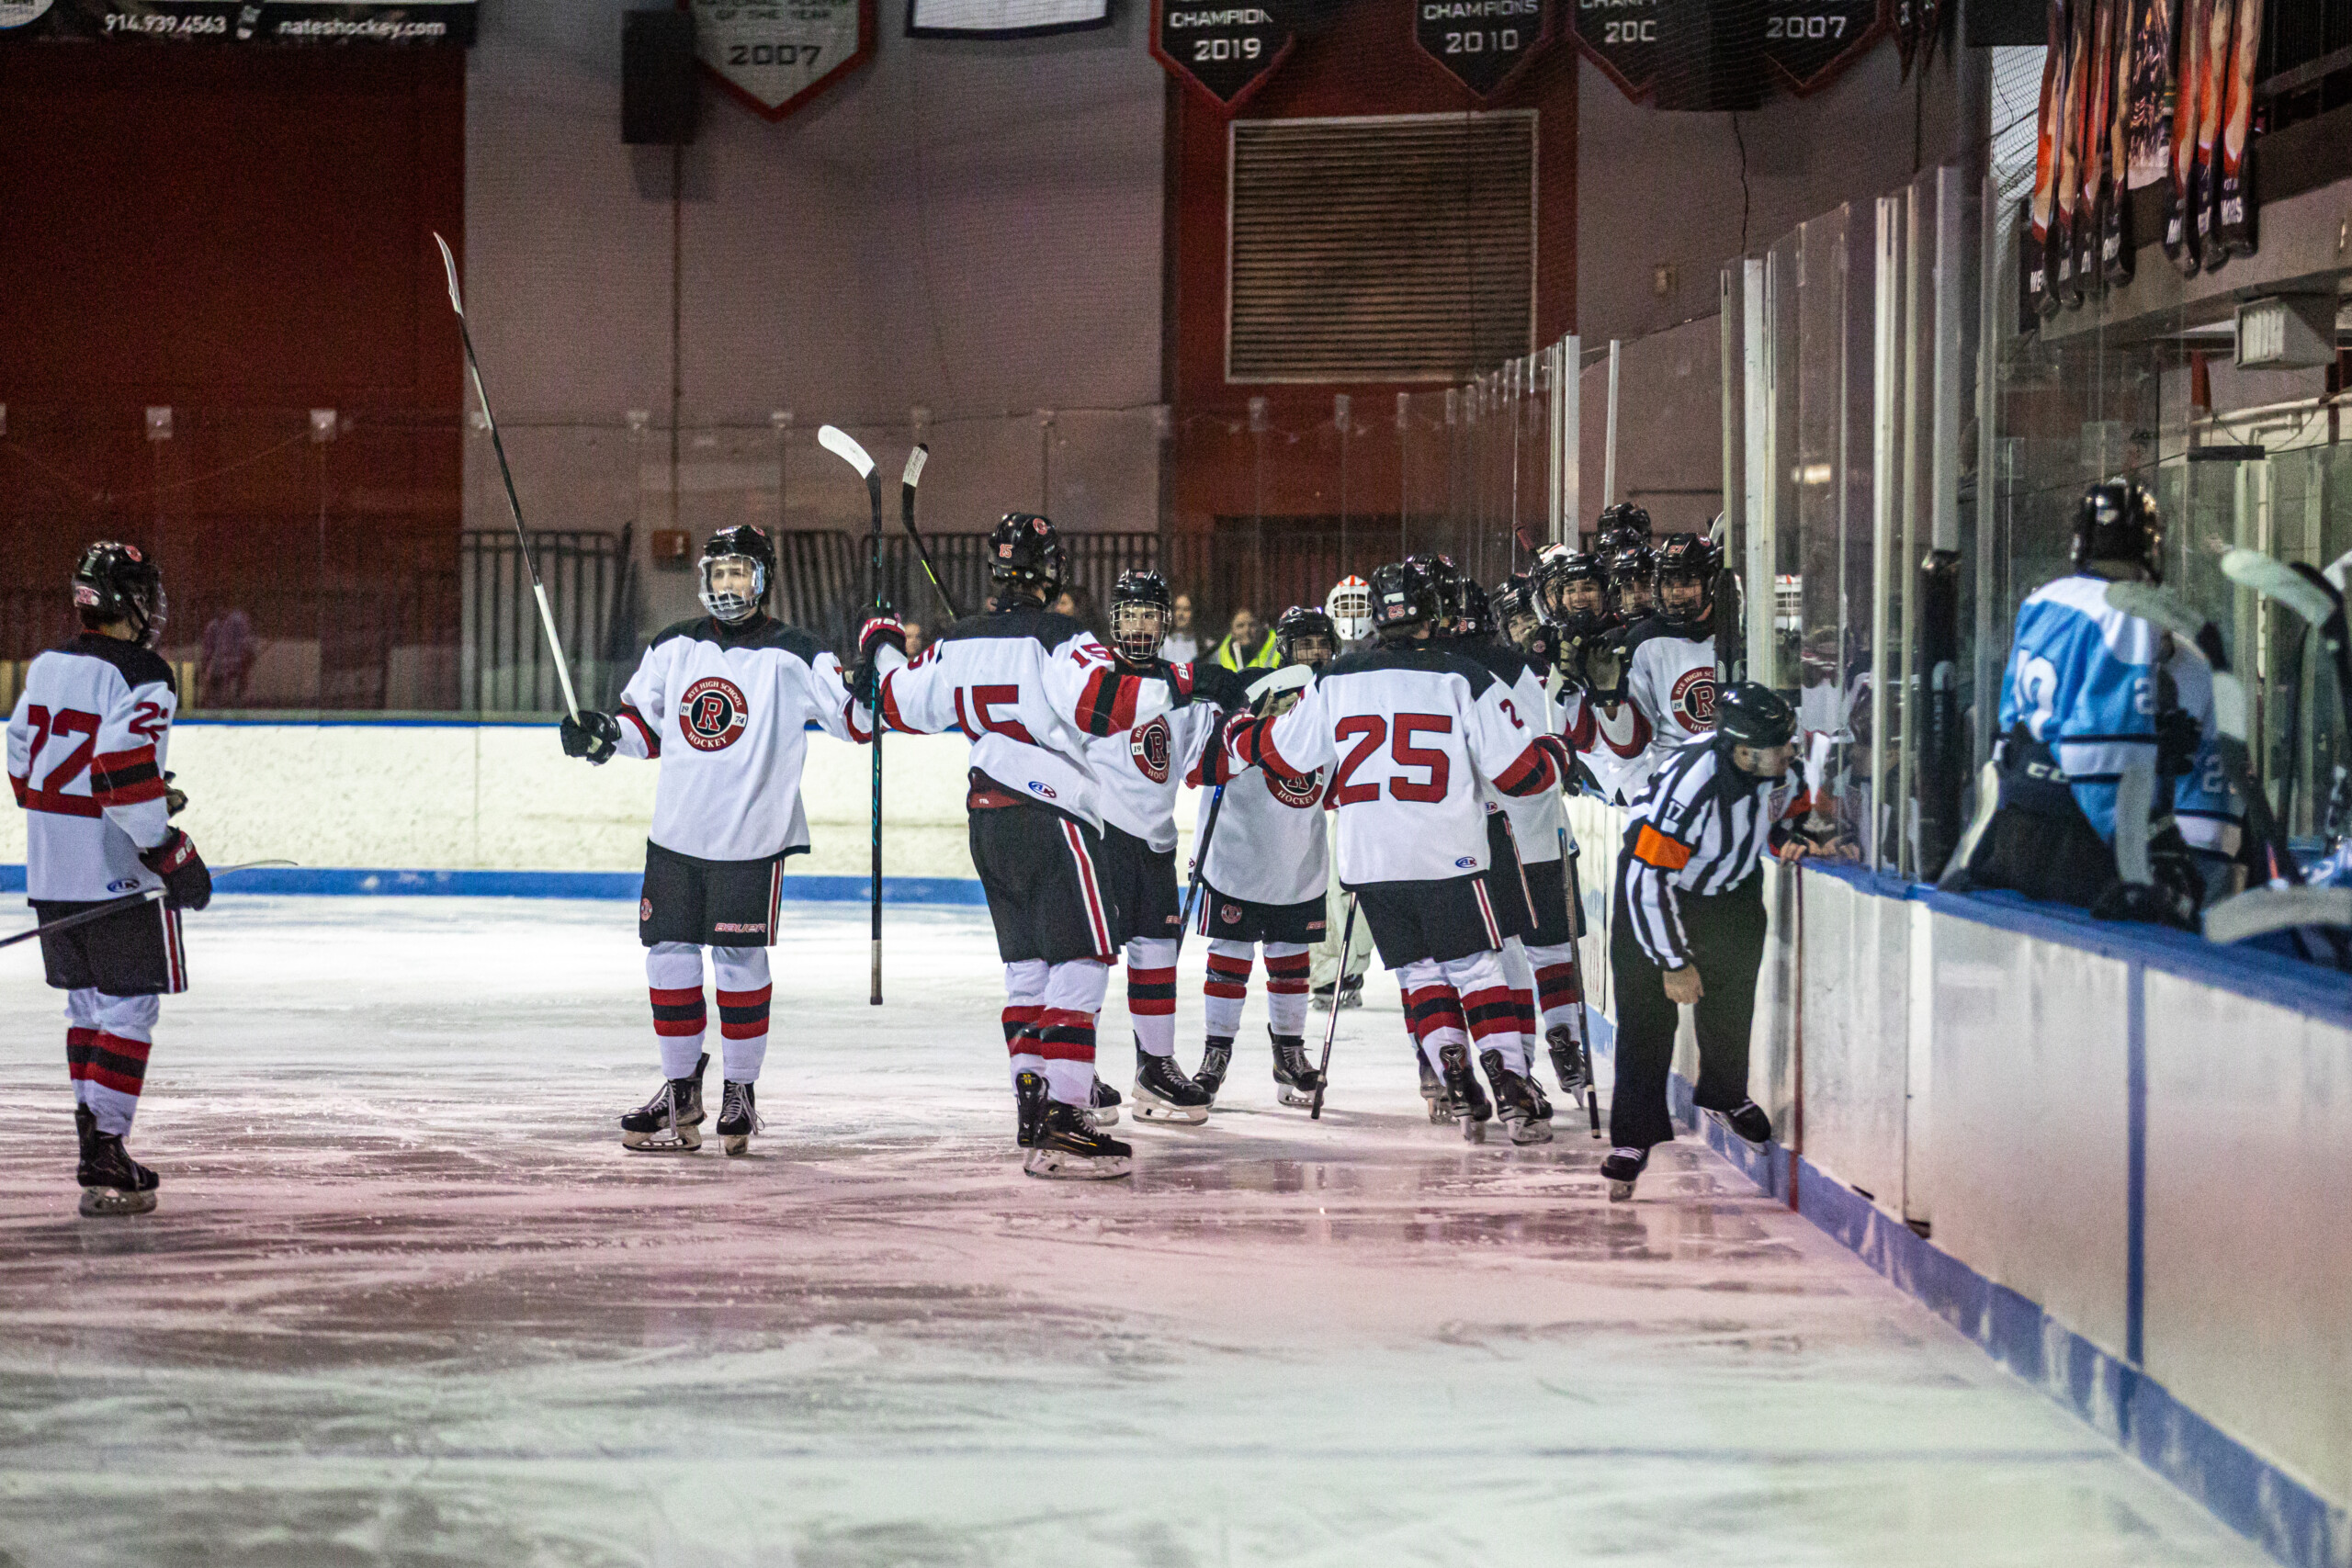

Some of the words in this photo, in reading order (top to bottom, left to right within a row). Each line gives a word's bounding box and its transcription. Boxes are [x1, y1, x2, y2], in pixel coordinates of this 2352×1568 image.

[277, 17, 447, 39] nateshockey.com
[1766, 16, 1847, 39] 2007
[1194, 38, 1261, 62] 2019
[1444, 28, 1519, 53] 2010
[728, 45, 821, 66] 2007
[999, 543, 1013, 558] 15
[1386, 604, 1406, 619] 25
[1070, 642, 1114, 669] 15
[1684, 671, 1702, 683] HIGH
[687, 686, 699, 700] RYE
[699, 681, 719, 690] HIGH
[720, 682, 743, 708] SCHOOL
[696, 695, 724, 732] R
[735, 716, 746, 724] 74
[687, 731, 728, 748] HOCKEY
[1133, 745, 1142, 753] 19
[1148, 731, 1166, 764] R
[1335, 712, 1453, 807] 25
[1276, 790, 1314, 805] HOCKEY
[1665, 800, 1685, 820] 17
[715, 922, 767, 932] BAUER
